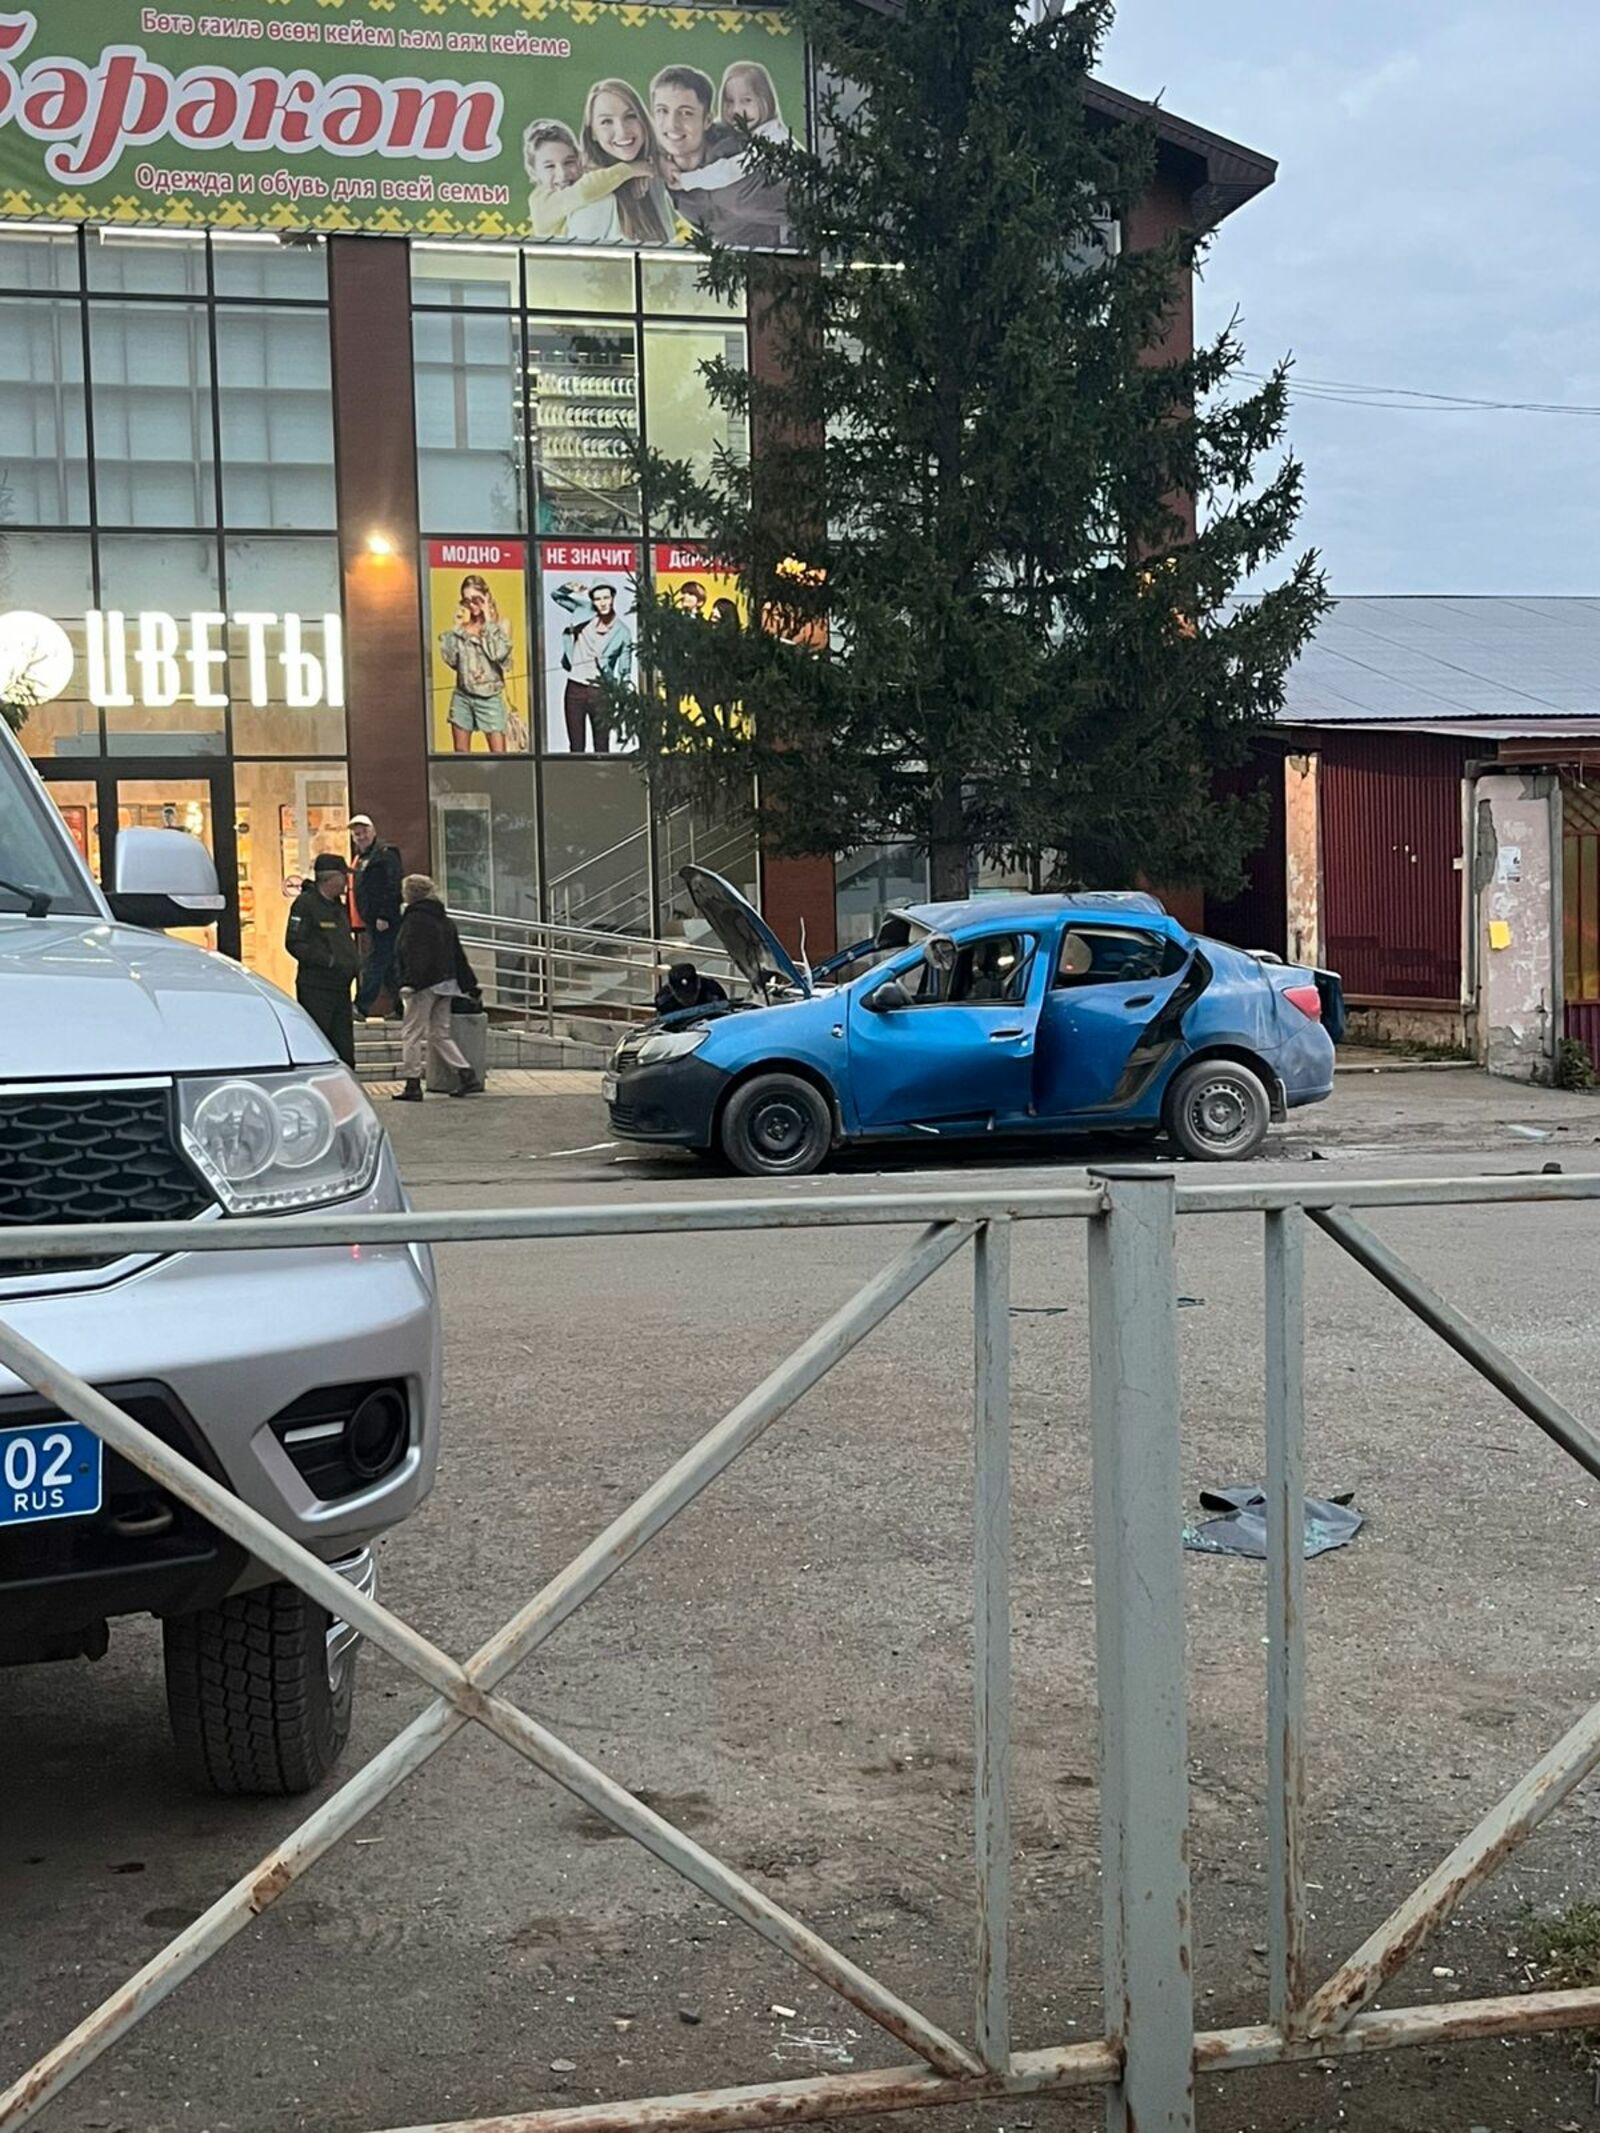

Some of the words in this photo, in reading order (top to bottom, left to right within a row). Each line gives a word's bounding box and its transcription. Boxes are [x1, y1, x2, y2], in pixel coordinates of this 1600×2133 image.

[142, 9, 194, 33] Бөтә
[199, 17, 262, 37] ғаилә
[268, 22, 319, 40] өсөн
[325, 21, 394, 45] кейем
[400, 29, 441, 48] һәм
[448, 32, 486, 51] аяҡ
[492, 31, 569, 55] кейеме
[136, 165, 232, 195] Одежда
[239, 175, 253, 193] и
[260, 170, 327, 199] обувь
[333, 180, 376, 200] для
[382, 176, 433, 199] всей
[440, 184, 508, 203] семьи
[442, 545, 500, 563] МОДНО
[546, 548, 567, 564] НЕ
[571, 548, 632, 566] ЗНАЧИТ
[85, 610, 345, 707] ЦВЕТЫ
[4, 1433, 73, 1490] 02
[14, 1488, 65, 1513] RUS
